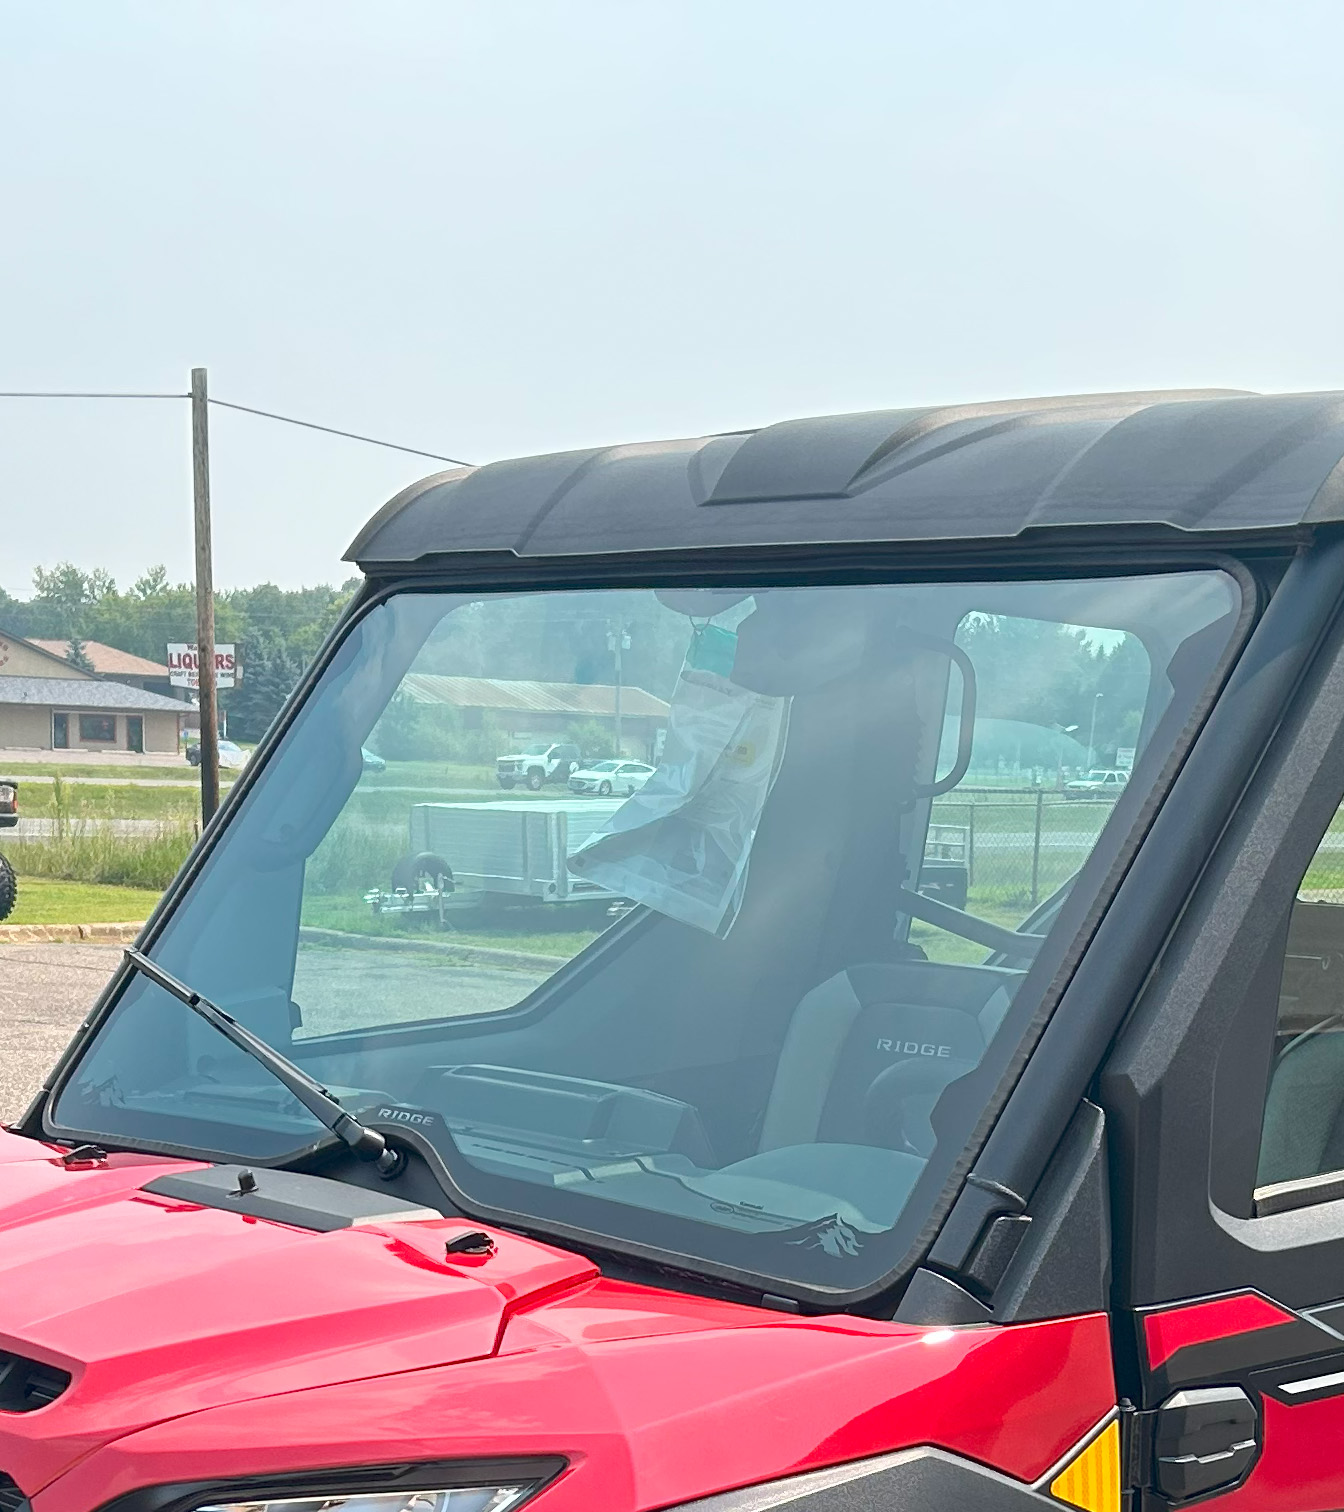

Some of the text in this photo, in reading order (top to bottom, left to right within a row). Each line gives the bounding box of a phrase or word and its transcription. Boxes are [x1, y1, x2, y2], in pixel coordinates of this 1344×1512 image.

[169, 653, 235, 670] LIQURS
[877, 1038, 952, 1058] RIDGE
[378, 1107, 435, 1127] RIDGE
